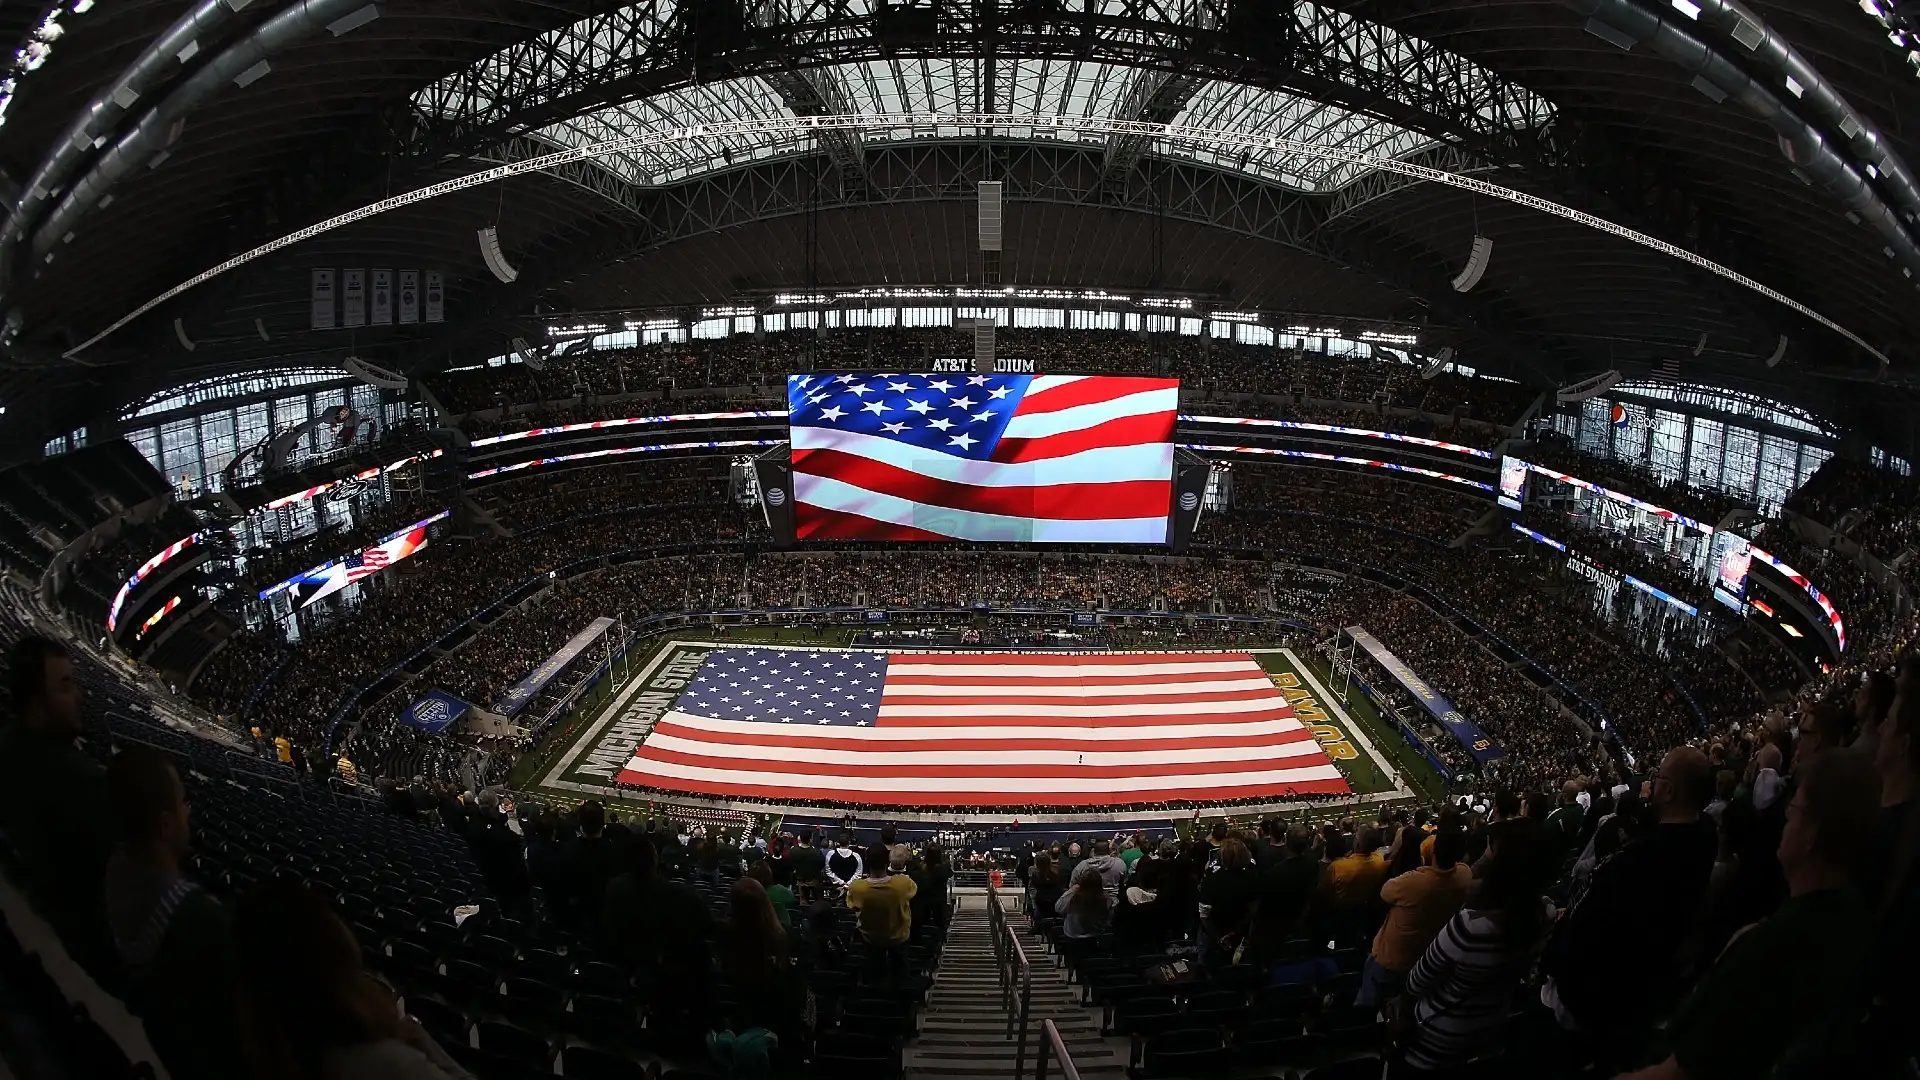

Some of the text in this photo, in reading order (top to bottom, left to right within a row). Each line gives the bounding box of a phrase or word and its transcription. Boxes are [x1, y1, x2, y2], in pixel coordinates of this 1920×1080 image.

[932, 358, 1035, 373] AT&T SDIUM
[1567, 556, 1621, 594] AT&T STADIUM
[649, 650, 710, 690] STATE
[575, 691, 677, 780] MICHIGAN
